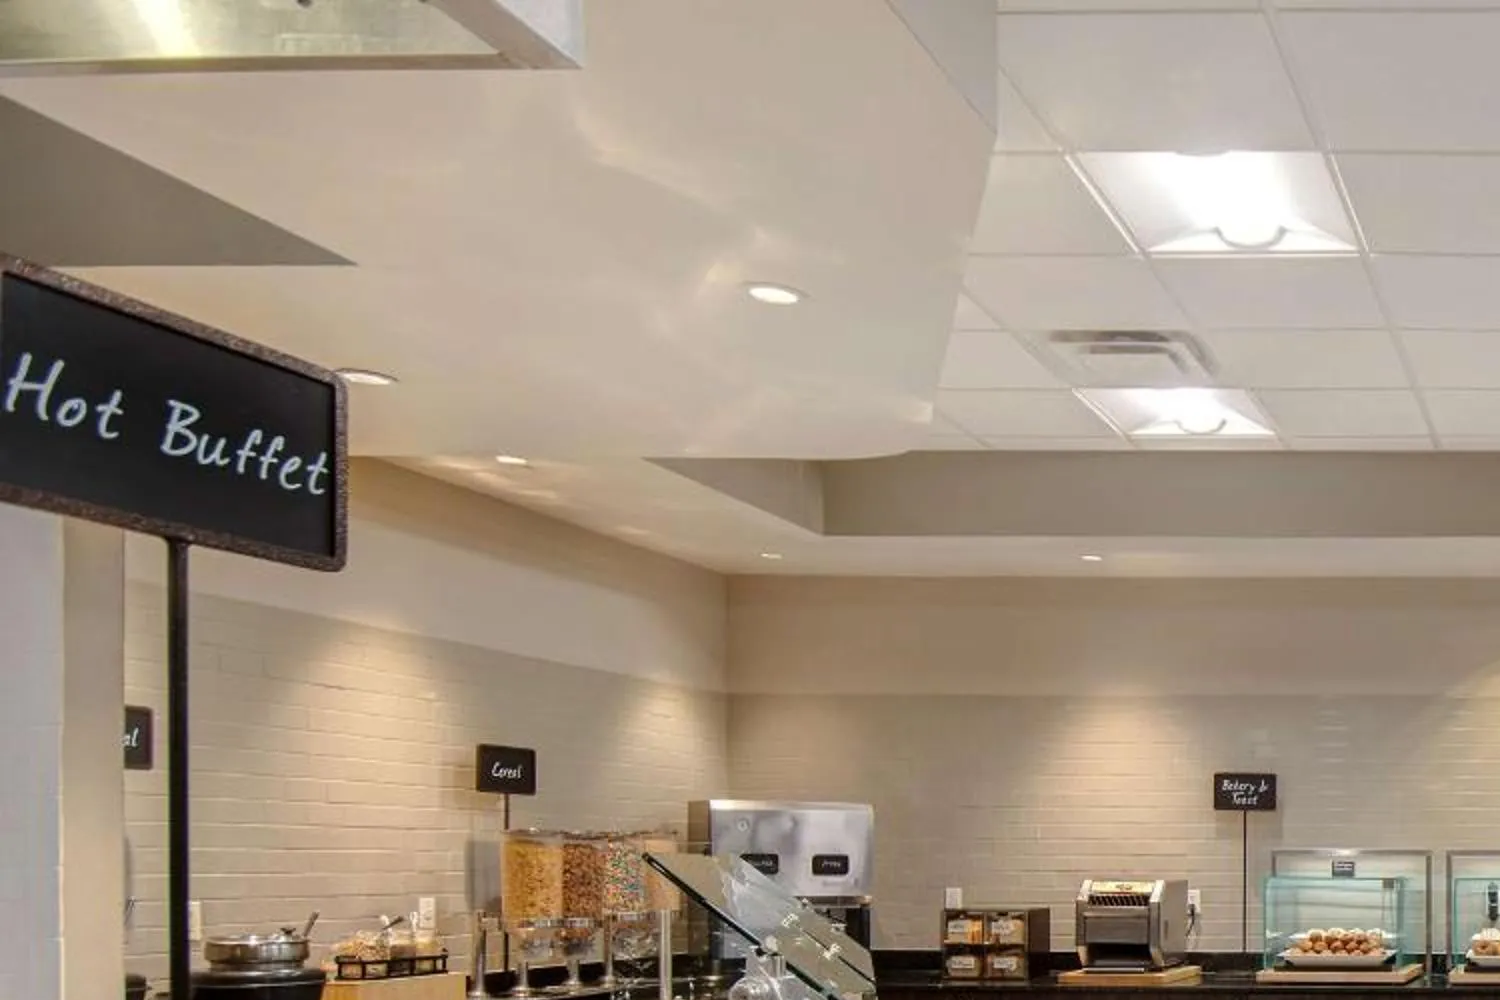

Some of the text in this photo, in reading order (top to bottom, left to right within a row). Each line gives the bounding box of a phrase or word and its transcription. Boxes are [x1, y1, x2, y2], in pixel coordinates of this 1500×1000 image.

[5, 352, 329, 495] Hot Buffet
[491, 761, 524, 779] Cereal
